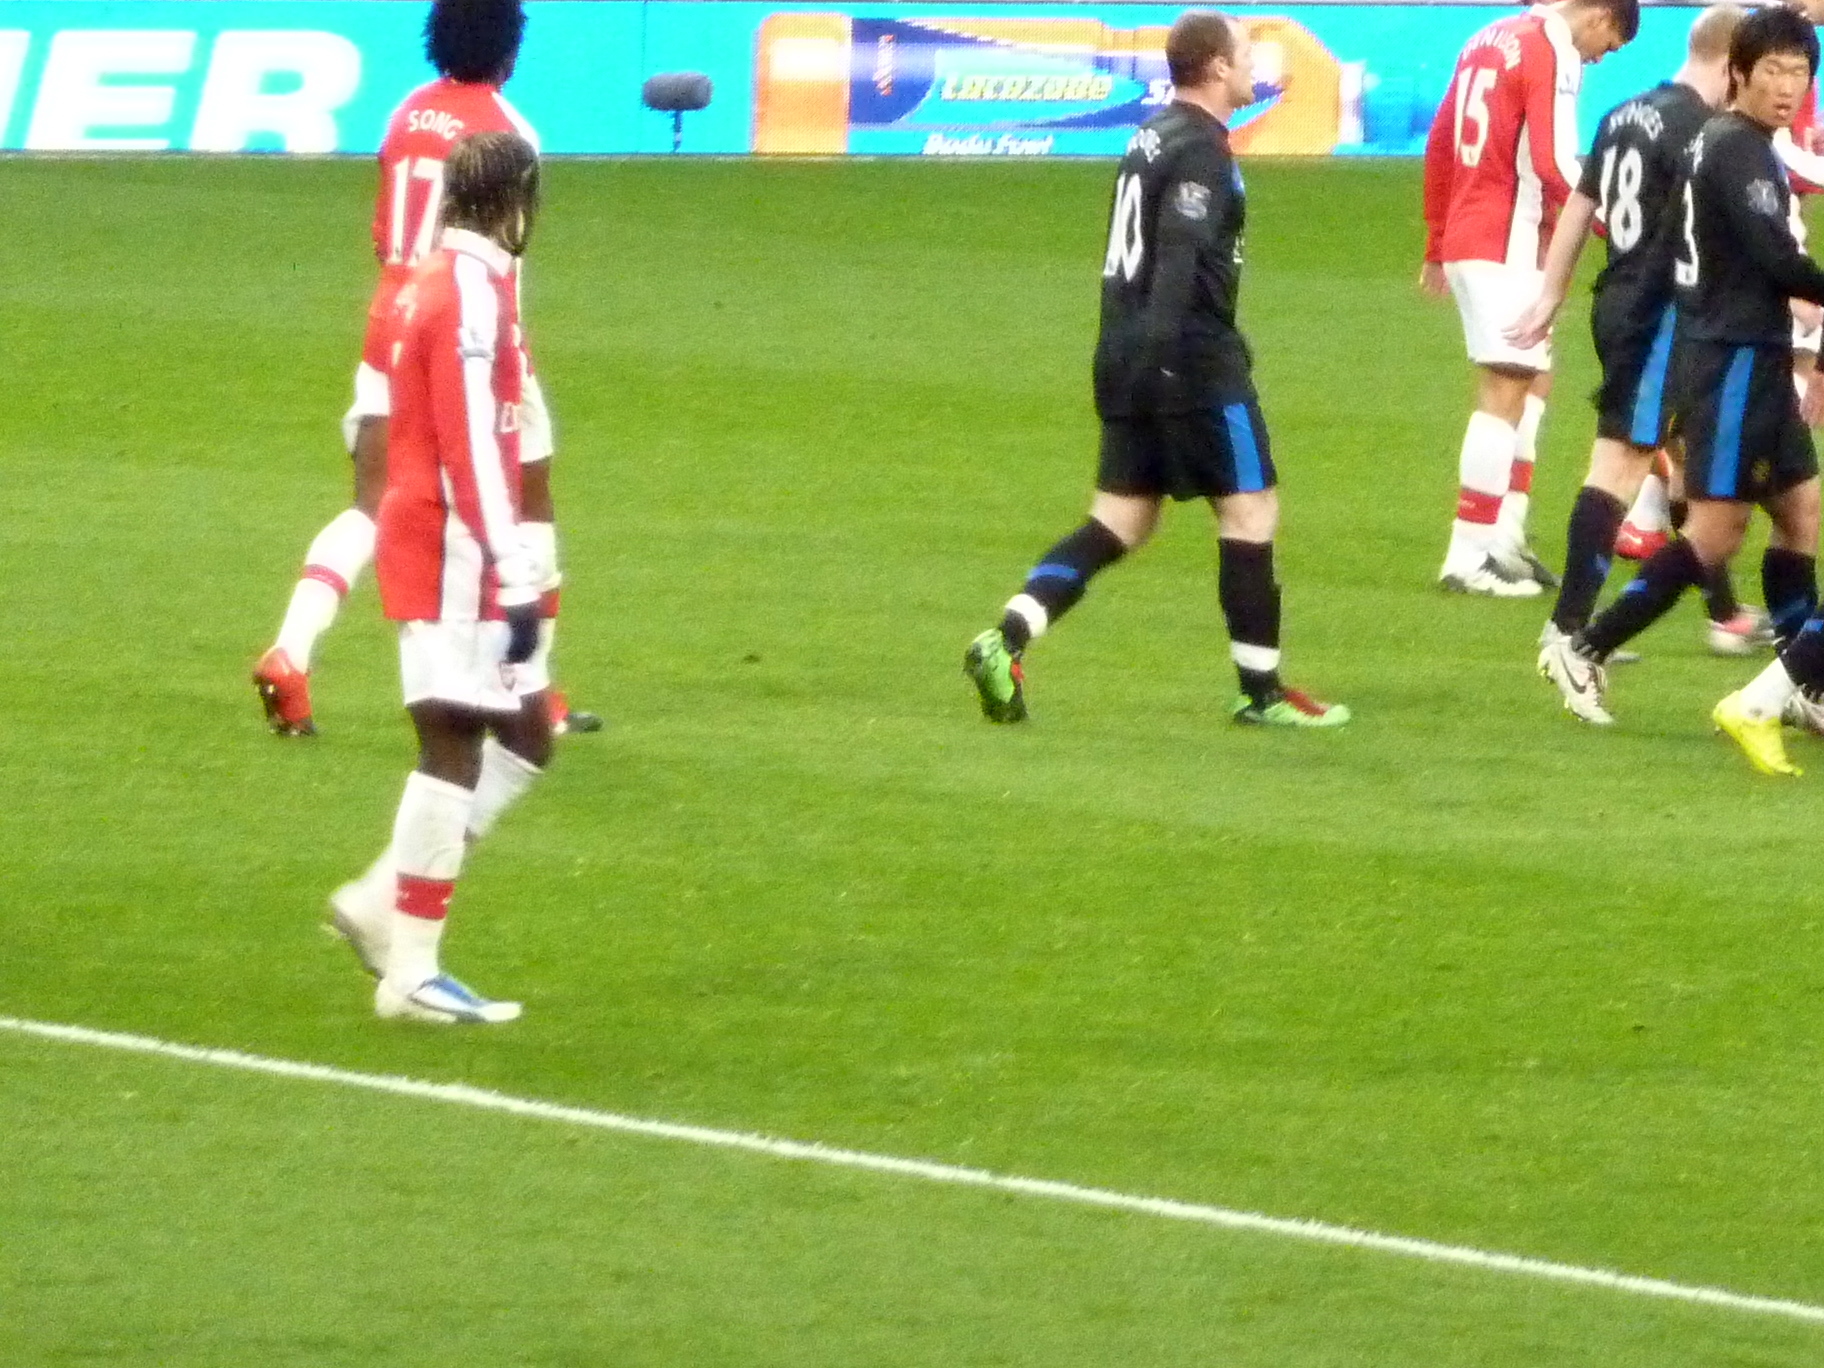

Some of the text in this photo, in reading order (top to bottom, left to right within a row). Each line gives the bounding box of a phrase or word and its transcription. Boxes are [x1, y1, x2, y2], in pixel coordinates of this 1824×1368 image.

[0, 28, 363, 153] ER
[408, 108, 465, 141] SONG
[1453, 66, 1498, 168] 15
[386, 155, 445, 268] 17
[1103, 172, 1144, 283] 10
[1599, 145, 1644, 253] 18
